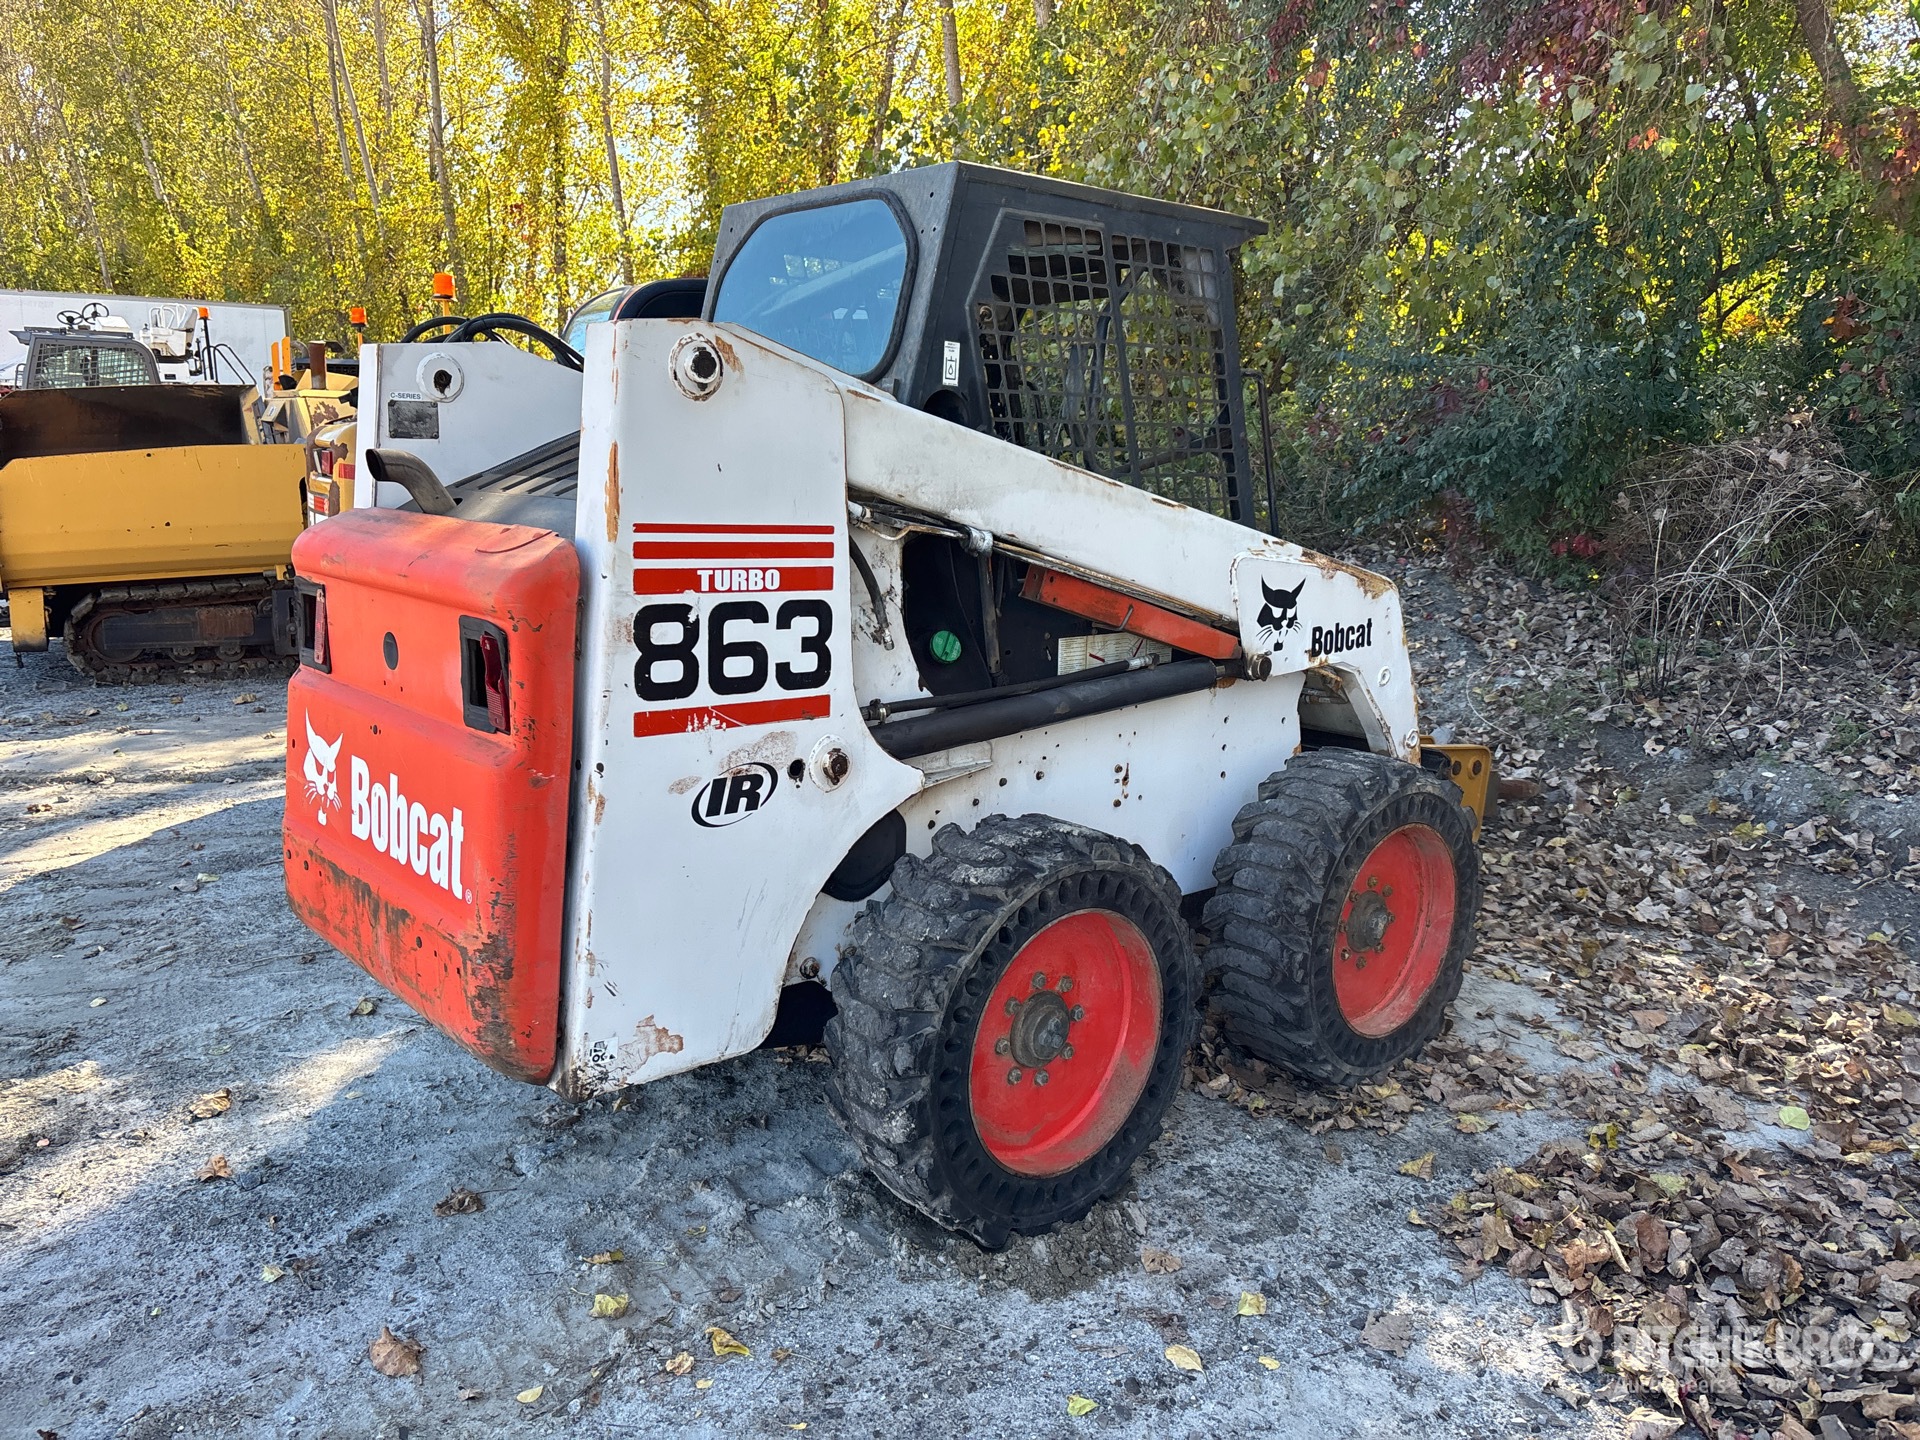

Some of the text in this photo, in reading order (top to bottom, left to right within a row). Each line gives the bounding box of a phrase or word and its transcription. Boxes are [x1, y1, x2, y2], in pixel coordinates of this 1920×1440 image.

[390, 392, 421, 400] C-SERIES
[697, 569, 780, 592] TURBO
[633, 599, 833, 702] 863
[1311, 617, 1373, 657] Bobcat
[705, 773, 764, 818] IR
[351, 754, 464, 900] Bobcat
